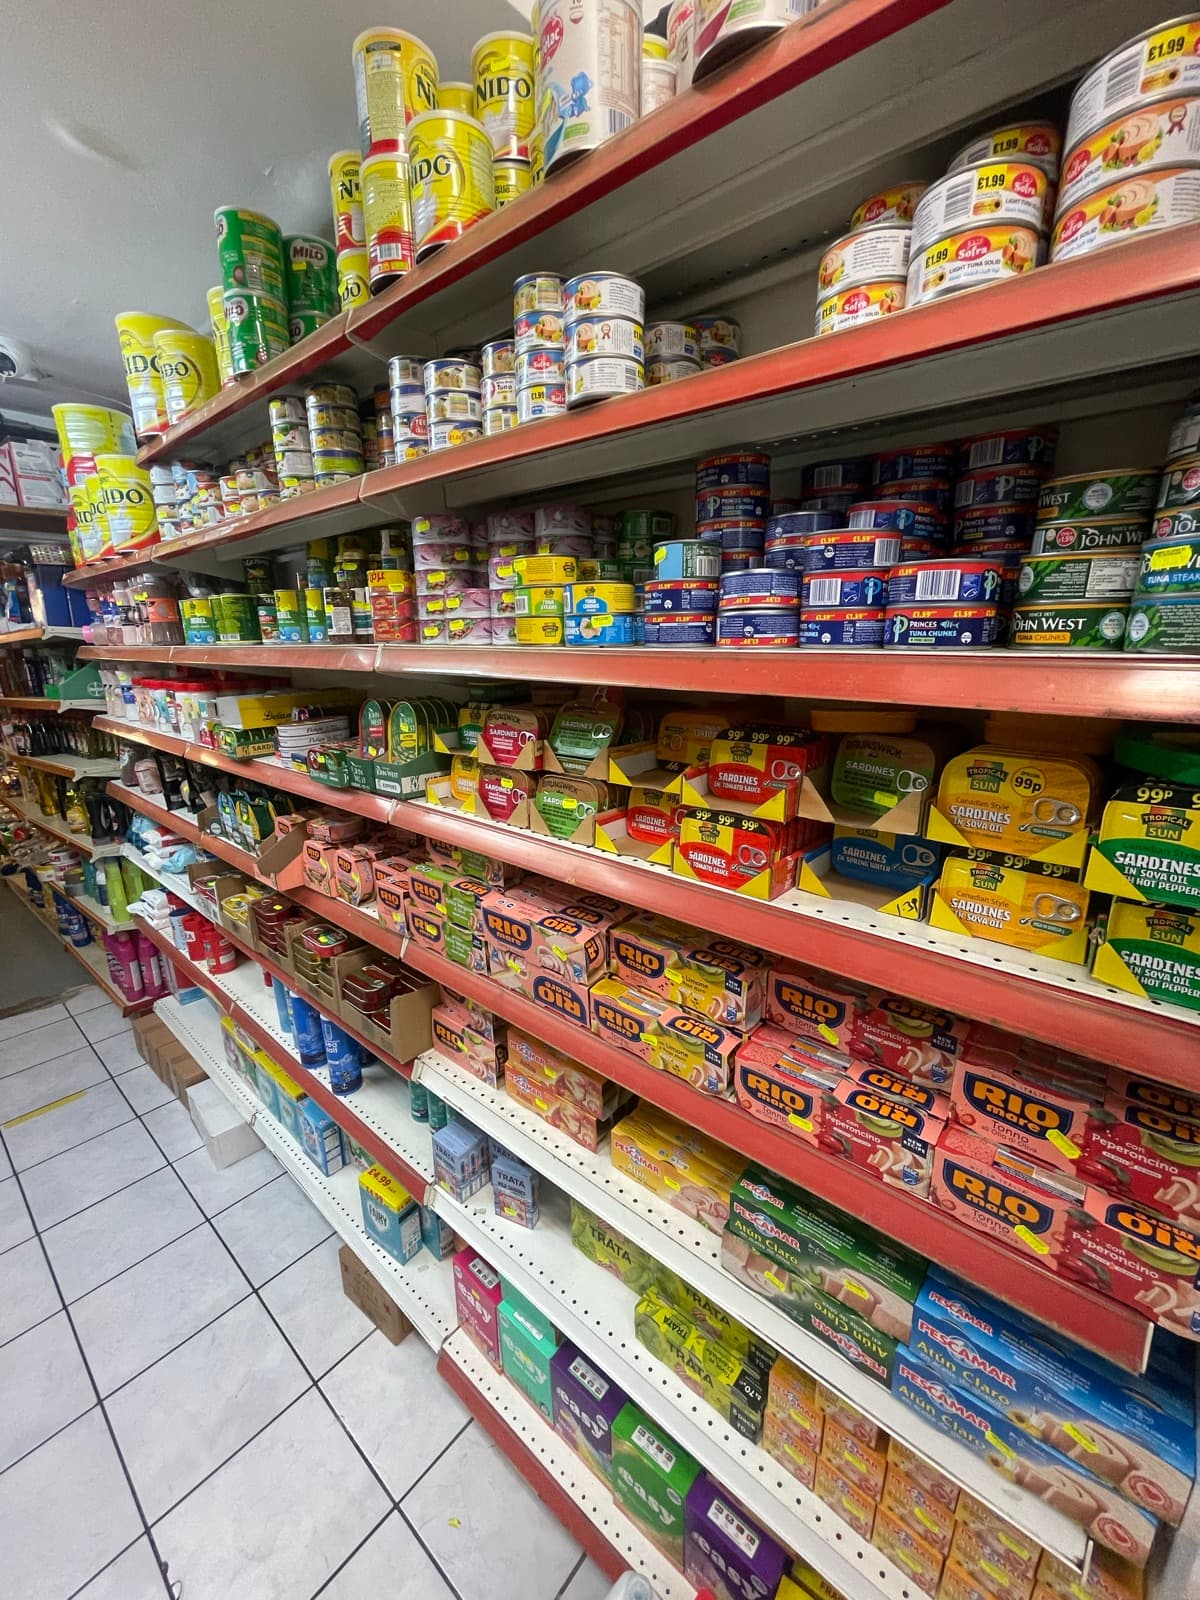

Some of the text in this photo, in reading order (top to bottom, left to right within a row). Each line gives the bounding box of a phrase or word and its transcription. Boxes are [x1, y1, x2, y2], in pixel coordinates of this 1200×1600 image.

[1147, 36, 1186, 62] £1.99
[476, 77, 531, 103] NIDO
[993, 138, 1018, 155] £1.99
[412, 154, 451, 185] IDO
[977, 174, 1006, 190] £1.99
[1013, 180, 1035, 196] Sofra
[292, 246, 324, 261] MILO
[925, 248, 948, 269] £1.99
[957, 244, 987, 260] Sofra
[949, 266, 965, 274] LIGHT
[822, 303, 837, 320] £1.99
[843, 299, 869, 313] Sofra
[103, 488, 144, 504] IDO
[1043, 492, 1071, 505] WEST
[1081, 532, 1122, 550] JOHN
[1147, 575, 1170, 584] TUNA
[909, 621, 937, 629] PRINCES
[1013, 617, 1087, 631] OHN WEST
[1017, 632, 1067, 641] TUNA CHUNKS
[490, 729, 518, 738] SARDINES
[562, 720, 593, 729] SARDINES
[728, 729, 796, 746] 99p 99p 99p
[846, 761, 895, 777] SARDINES
[967, 767, 1008, 782] TROPICAL
[717, 772, 759, 786] SARDINES
[972, 779, 998, 792] SUN
[1013, 777, 1042, 794] 99p
[485, 783, 511, 795] SARDINES
[744, 785, 761, 794] SAUCE
[1136, 786, 1173, 804] 99p
[543, 796, 563, 805] SARDI
[955, 796, 1010, 813] Canadian Style
[634, 815, 666, 827] SARDINES
[695, 809, 759, 831] 99p 99p 99p
[950, 804, 1011, 825] SARDINES
[1142, 812, 1193, 830] TROPICAL
[965, 819, 1004, 833] SOYA OIL
[1148, 826, 1180, 840] SUN
[702, 835, 716, 843] SUN
[688, 850, 726, 866] SARDINES
[842, 846, 887, 864] SARDINES
[967, 848, 1070, 877] 99p 99p 99p
[712, 866, 729, 877] SAUCE
[971, 867, 1005, 881] TROPICAL
[1123, 866, 1189, 886] IN SOYA OIL
[414, 883, 440, 899] RIO
[974, 879, 996, 891] SUN
[1136, 878, 1162, 890] HOT
[381, 891, 400, 907] RIO
[956, 890, 1010, 909] Canadian Style
[950, 897, 1011, 921] SARDINES
[488, 915, 528, 942] RIO
[543, 917, 577, 935] RIO
[965, 912, 1004, 929] SOYA OIL
[1146, 917, 1195, 935] TROPICAL
[496, 931, 521, 946] mare
[1151, 929, 1182, 944] SUN
[619, 943, 660, 970] RIO
[626, 959, 652, 975] mare
[685, 976, 709, 990] Limone
[1143, 968, 1191, 988] SOYA OIL
[538, 984, 581, 1018] RIO
[782, 986, 838, 1019] RIO
[600, 1004, 640, 1034] RIO
[791, 1005, 826, 1024] mare
[606, 1021, 633, 1038] mare
[674, 1020, 720, 1044] RIO
[857, 1019, 912, 1045] Peperoncino
[666, 1043, 689, 1057] Limone
[932, 1038, 956, 1051] RECIPE
[747, 1073, 805, 1111] RIO
[868, 1074, 928, 1104] RIO
[757, 1092, 793, 1115] mare
[855, 1094, 918, 1128] RIO
[973, 1080, 1060, 1128] RIO
[986, 1104, 1041, 1133] mare
[825, 1113, 881, 1144] Peperoncino
[991, 1120, 1030, 1144] Tonno
[1091, 1132, 1179, 1176] Peperoncino
[1125, 1141, 1146, 1154] con
[614, 1141, 661, 1176] PESCAMAR
[368, 1168, 392, 1187] £4.99
[496, 1171, 526, 1189] TRATA
[740, 1178, 785, 1210] PESCAMAR
[952, 1168, 1040, 1224] RIO
[368, 1203, 388, 1227] FAIRY
[965, 1193, 1021, 1225] mare
[733, 1201, 800, 1251] PESCAMAR
[971, 1208, 1011, 1235] Tonno
[589, 1224, 632, 1265] TRATA
[765, 1238, 799, 1265] Claro
[1105, 1242, 1126, 1256] con
[1072, 1231, 1160, 1280] Peperoncino
[457, 1281, 493, 1325] easy
[929, 1291, 993, 1337] PESCAMAR
[662, 1315, 688, 1339] TRATA
[811, 1315, 888, 1380] PESCAMAR
[918, 1319, 1017, 1392] PESCAMAR
[502, 1332, 548, 1385] easy
[668, 1343, 714, 1389] TRATA
[917, 1341, 1010, 1406] Atún Claro
[899, 1364, 992, 1432] PESCAMAR
[555, 1385, 606, 1440] easy
[899, 1384, 986, 1450] Atún Claro
[617, 1464, 677, 1526] easy
